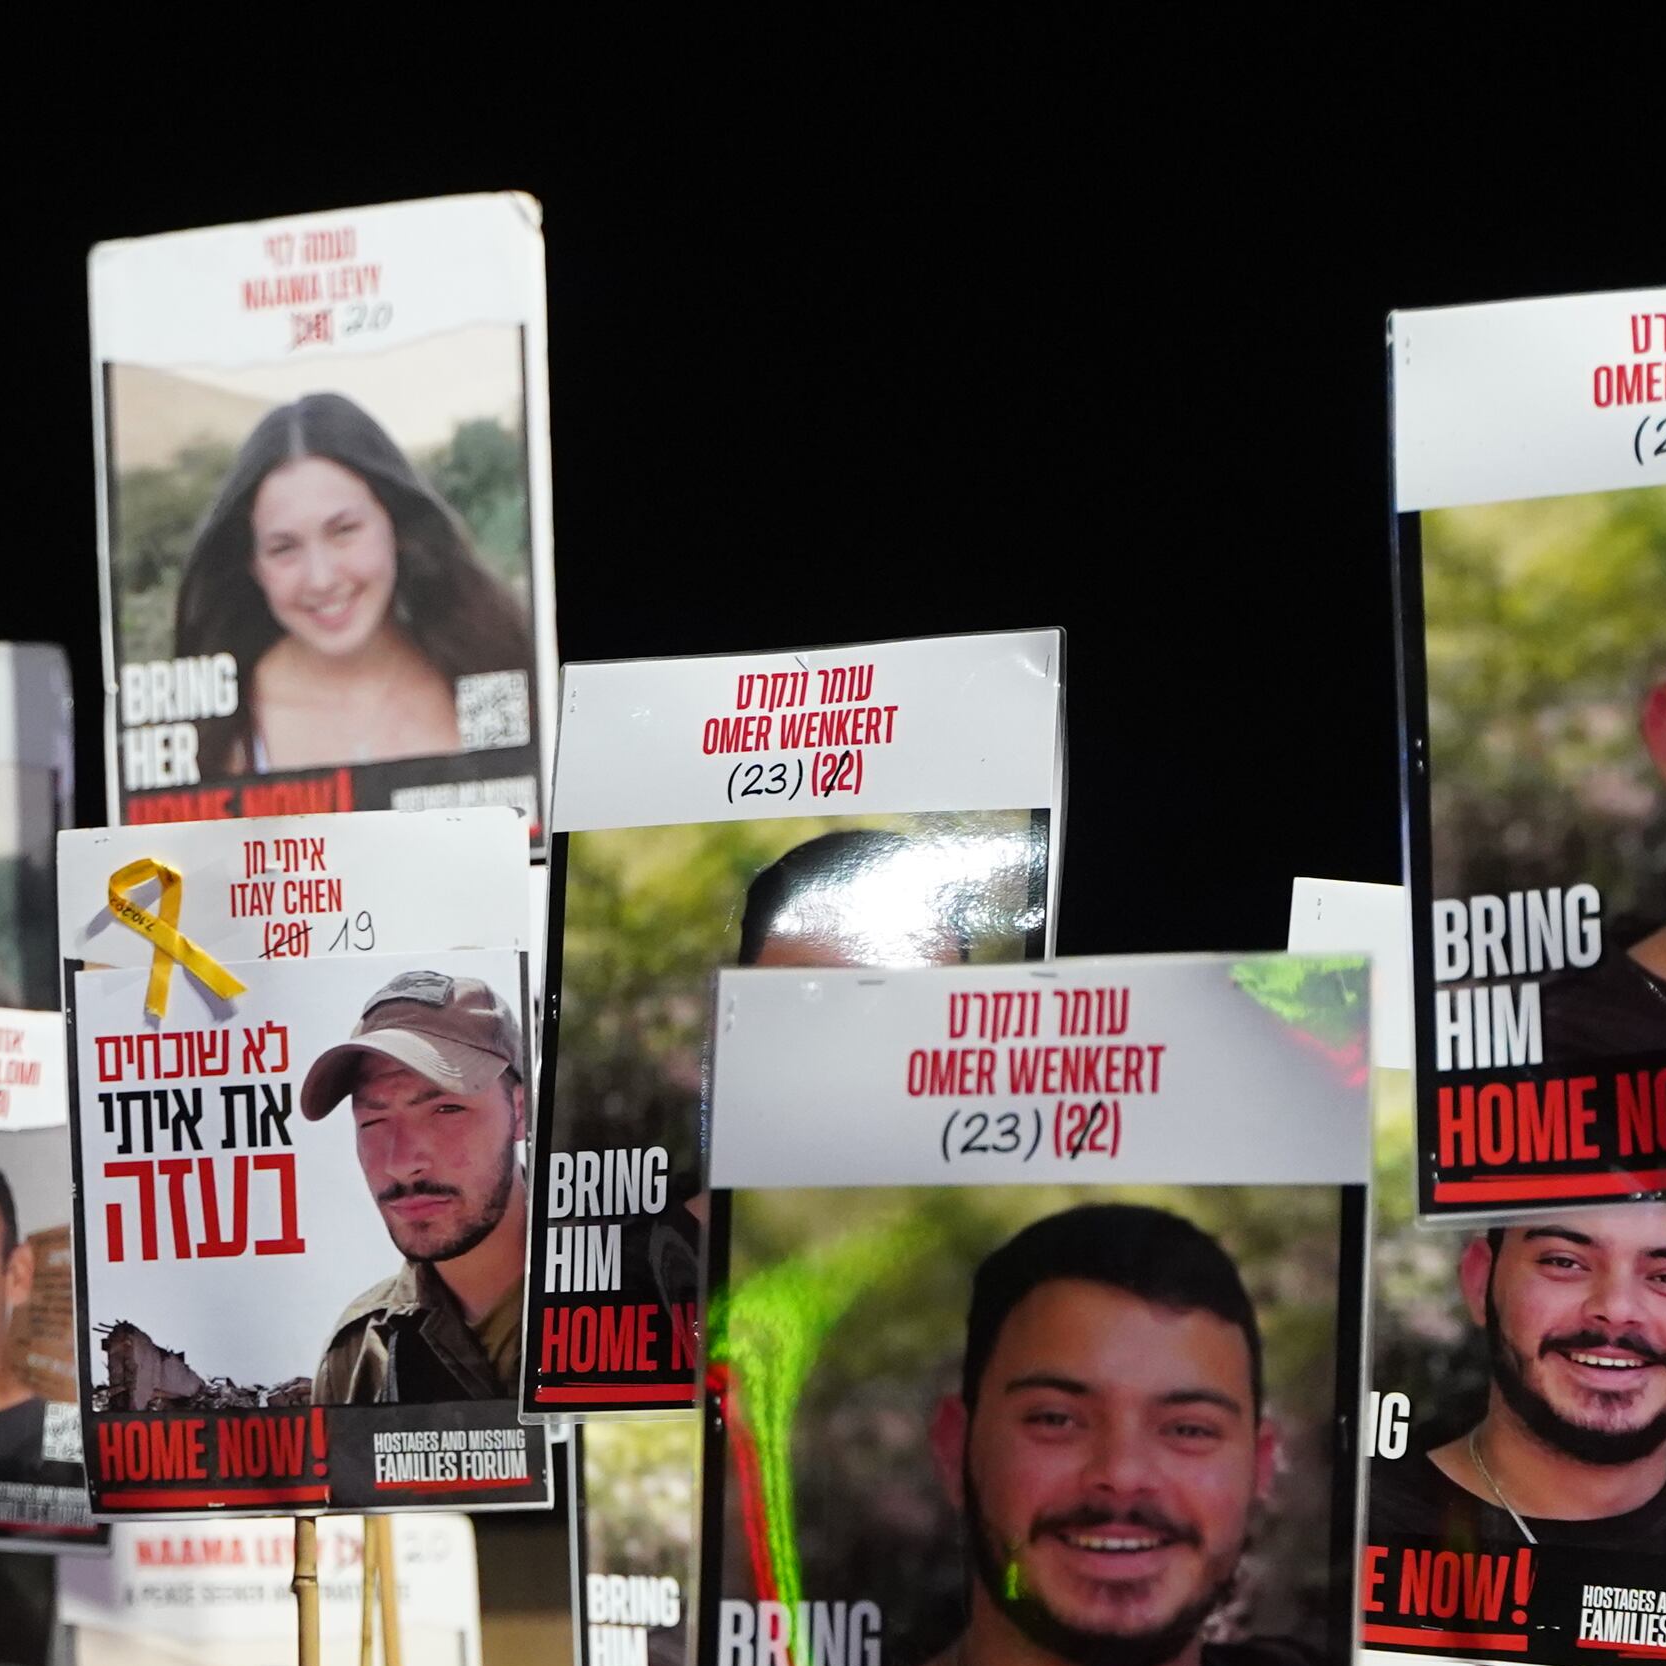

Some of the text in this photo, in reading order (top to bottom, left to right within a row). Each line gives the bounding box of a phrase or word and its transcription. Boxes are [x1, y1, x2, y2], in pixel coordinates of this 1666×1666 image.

[120, 653, 238, 727] BRING
[736, 664, 874, 712] עומר ונקרט
[123, 722, 200, 791] HER
[702, 706, 898, 755] OMER WENKERT
[727, 758, 803, 804] (23)
[243, 837, 326, 879] איתי חן
[230, 879, 343, 917] ITAY CHEN
[264, 910, 375, 959] (20) 19
[1432, 882, 1603, 983] BRING
[948, 986, 1130, 1044] עומר ונקרט
[1435, 981, 1543, 1073] HIM
[95, 1020, 289, 1082] לא שוכחים
[907, 1045, 1167, 1097] OMER WENKERT
[98, 1082, 293, 1154] את איתי
[941, 1107, 1043, 1163] (23)
[1438, 1075, 1601, 1169] HOME
[103, 1153, 306, 1263] בעזה
[547, 1146, 669, 1219] BRING
[544, 1223, 623, 1294] HIM
[541, 1303, 659, 1375] HOME
[97, 1407, 329, 1482] HOME NOW!
[373, 1428, 526, 1453] HOSTAGES AND MISSING
[374, 1449, 527, 1483] FAMILIES FORUM
[587, 1572, 680, 1628] BRING
[1399, 1547, 1533, 1625] NOW!
[1583, 1584, 1656, 1613] HOSTAGES
